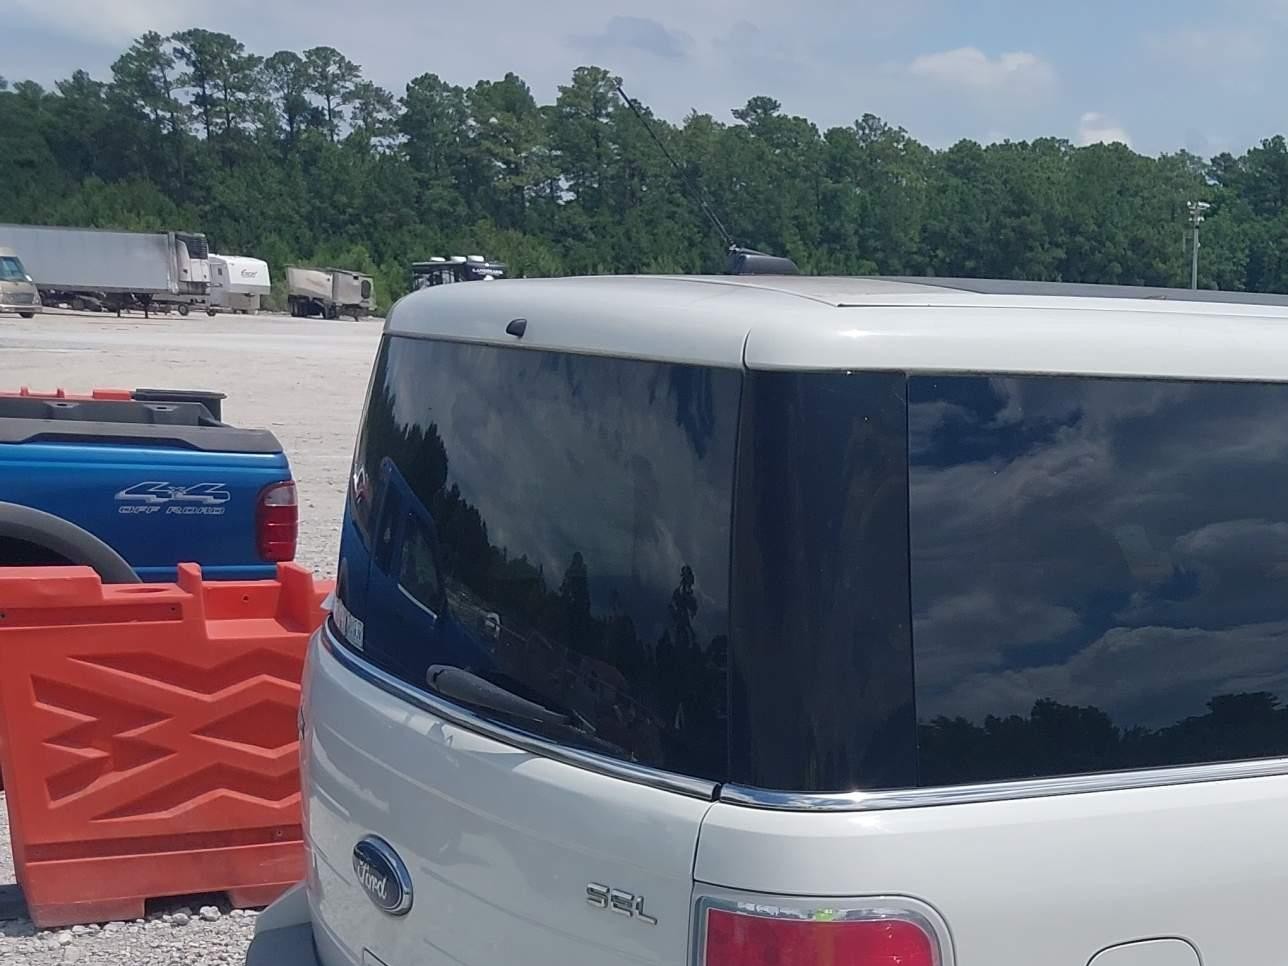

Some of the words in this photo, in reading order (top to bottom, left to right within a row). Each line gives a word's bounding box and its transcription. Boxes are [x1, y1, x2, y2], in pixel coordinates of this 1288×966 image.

[118, 505, 161, 514] OFF
[166, 505, 226, 515] ROAD
[356, 860, 389, 901] Ford
[585, 881, 659, 926] SEL
